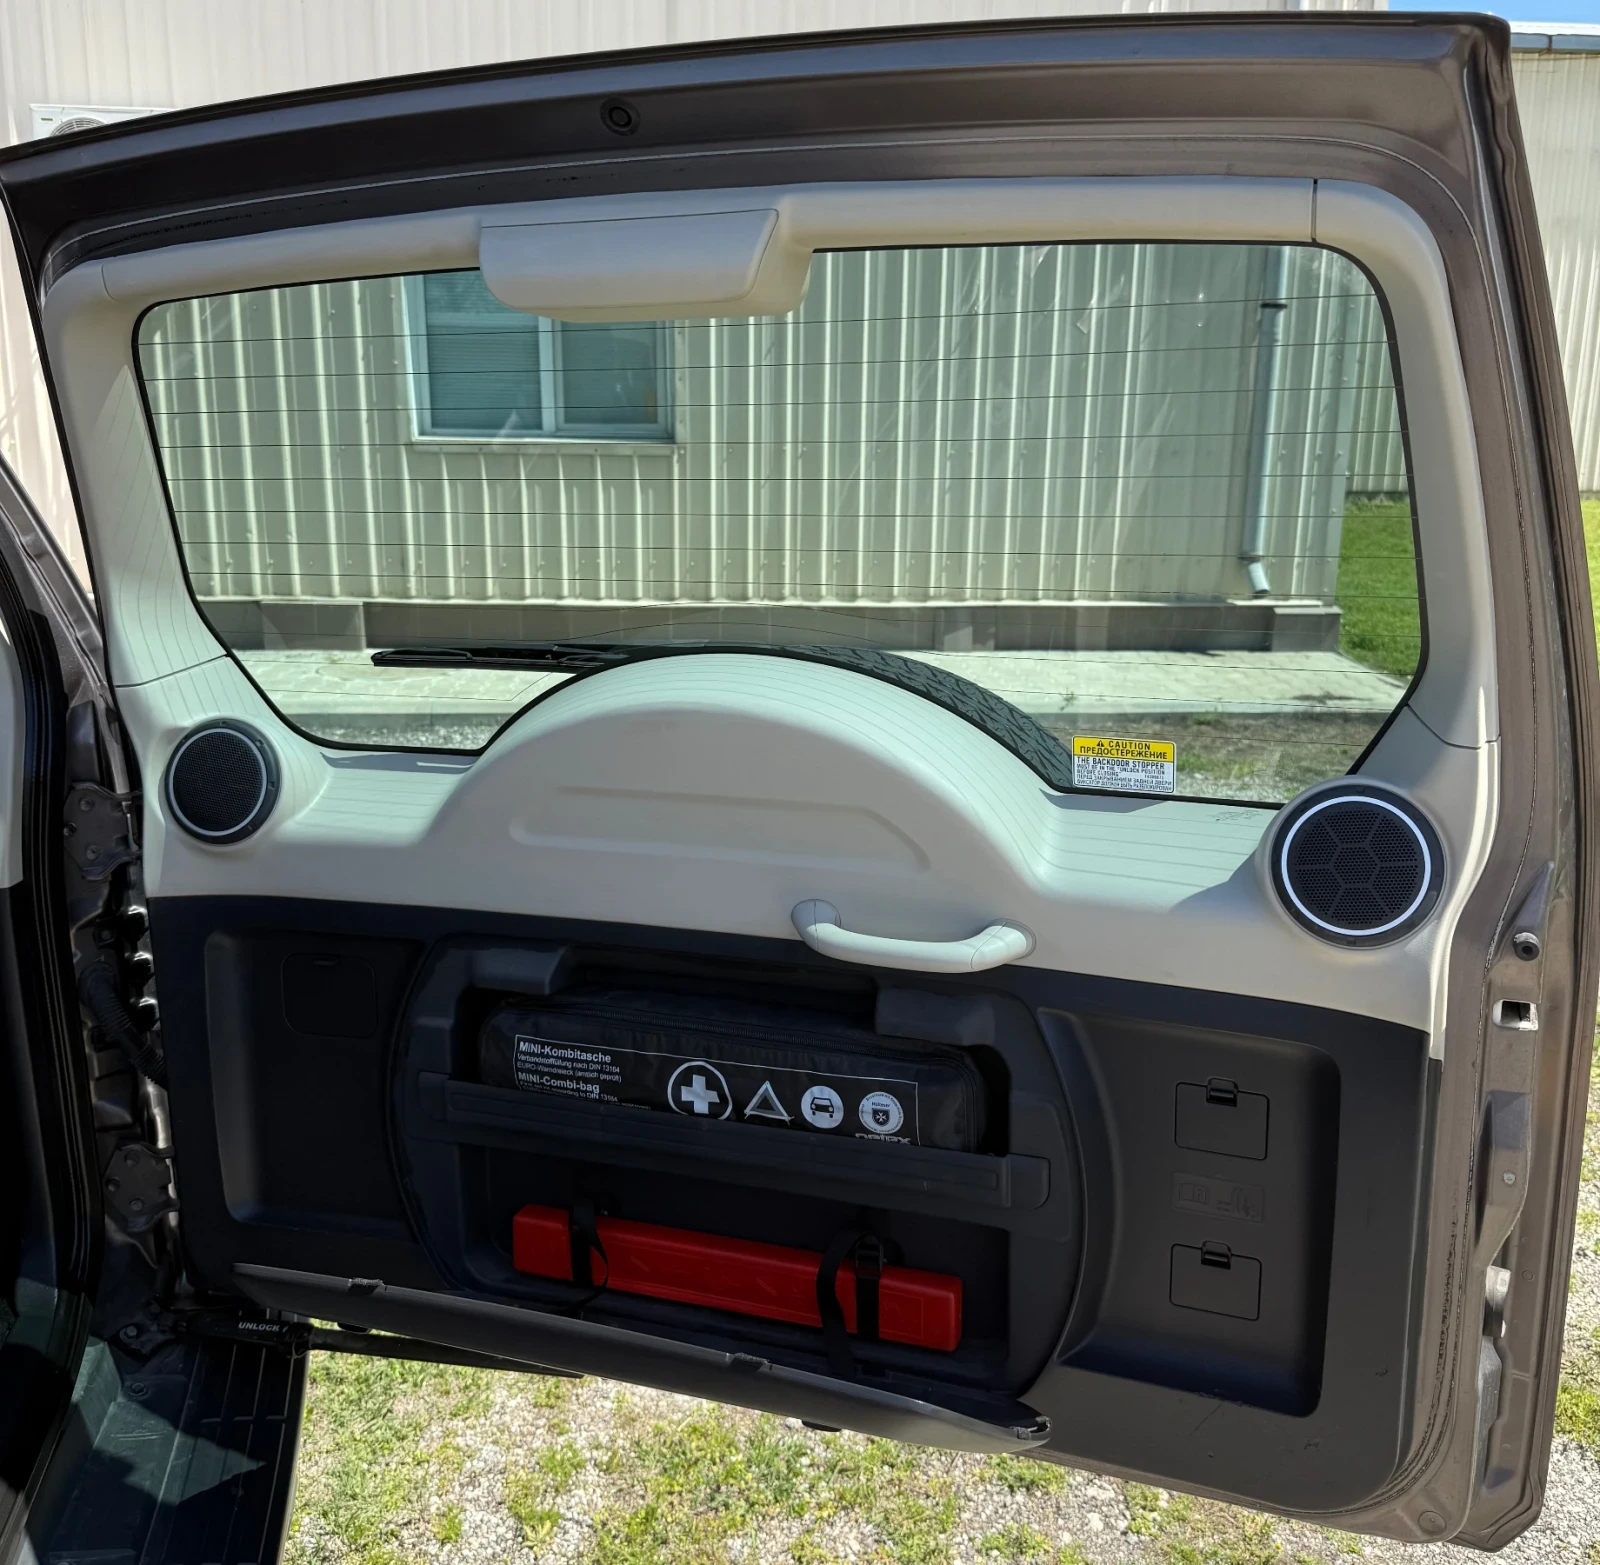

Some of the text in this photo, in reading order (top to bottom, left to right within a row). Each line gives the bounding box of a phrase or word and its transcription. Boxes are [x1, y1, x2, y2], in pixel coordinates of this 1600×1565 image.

[1108, 740, 1151, 750] CAUTION
[1080, 746, 1168, 760] ПРЕДОСТЕРЕЖЕНИЕ
[1092, 758, 1130, 767] BACKDOOR
[1132, 760, 1165, 769] STOPPER
[573, 1061, 587, 1069] nach
[602, 1064, 620, 1073] 13164
[518, 1071, 600, 1094] MINI-Combi-bag
[238, 1321, 281, 1332] UNLOCK
